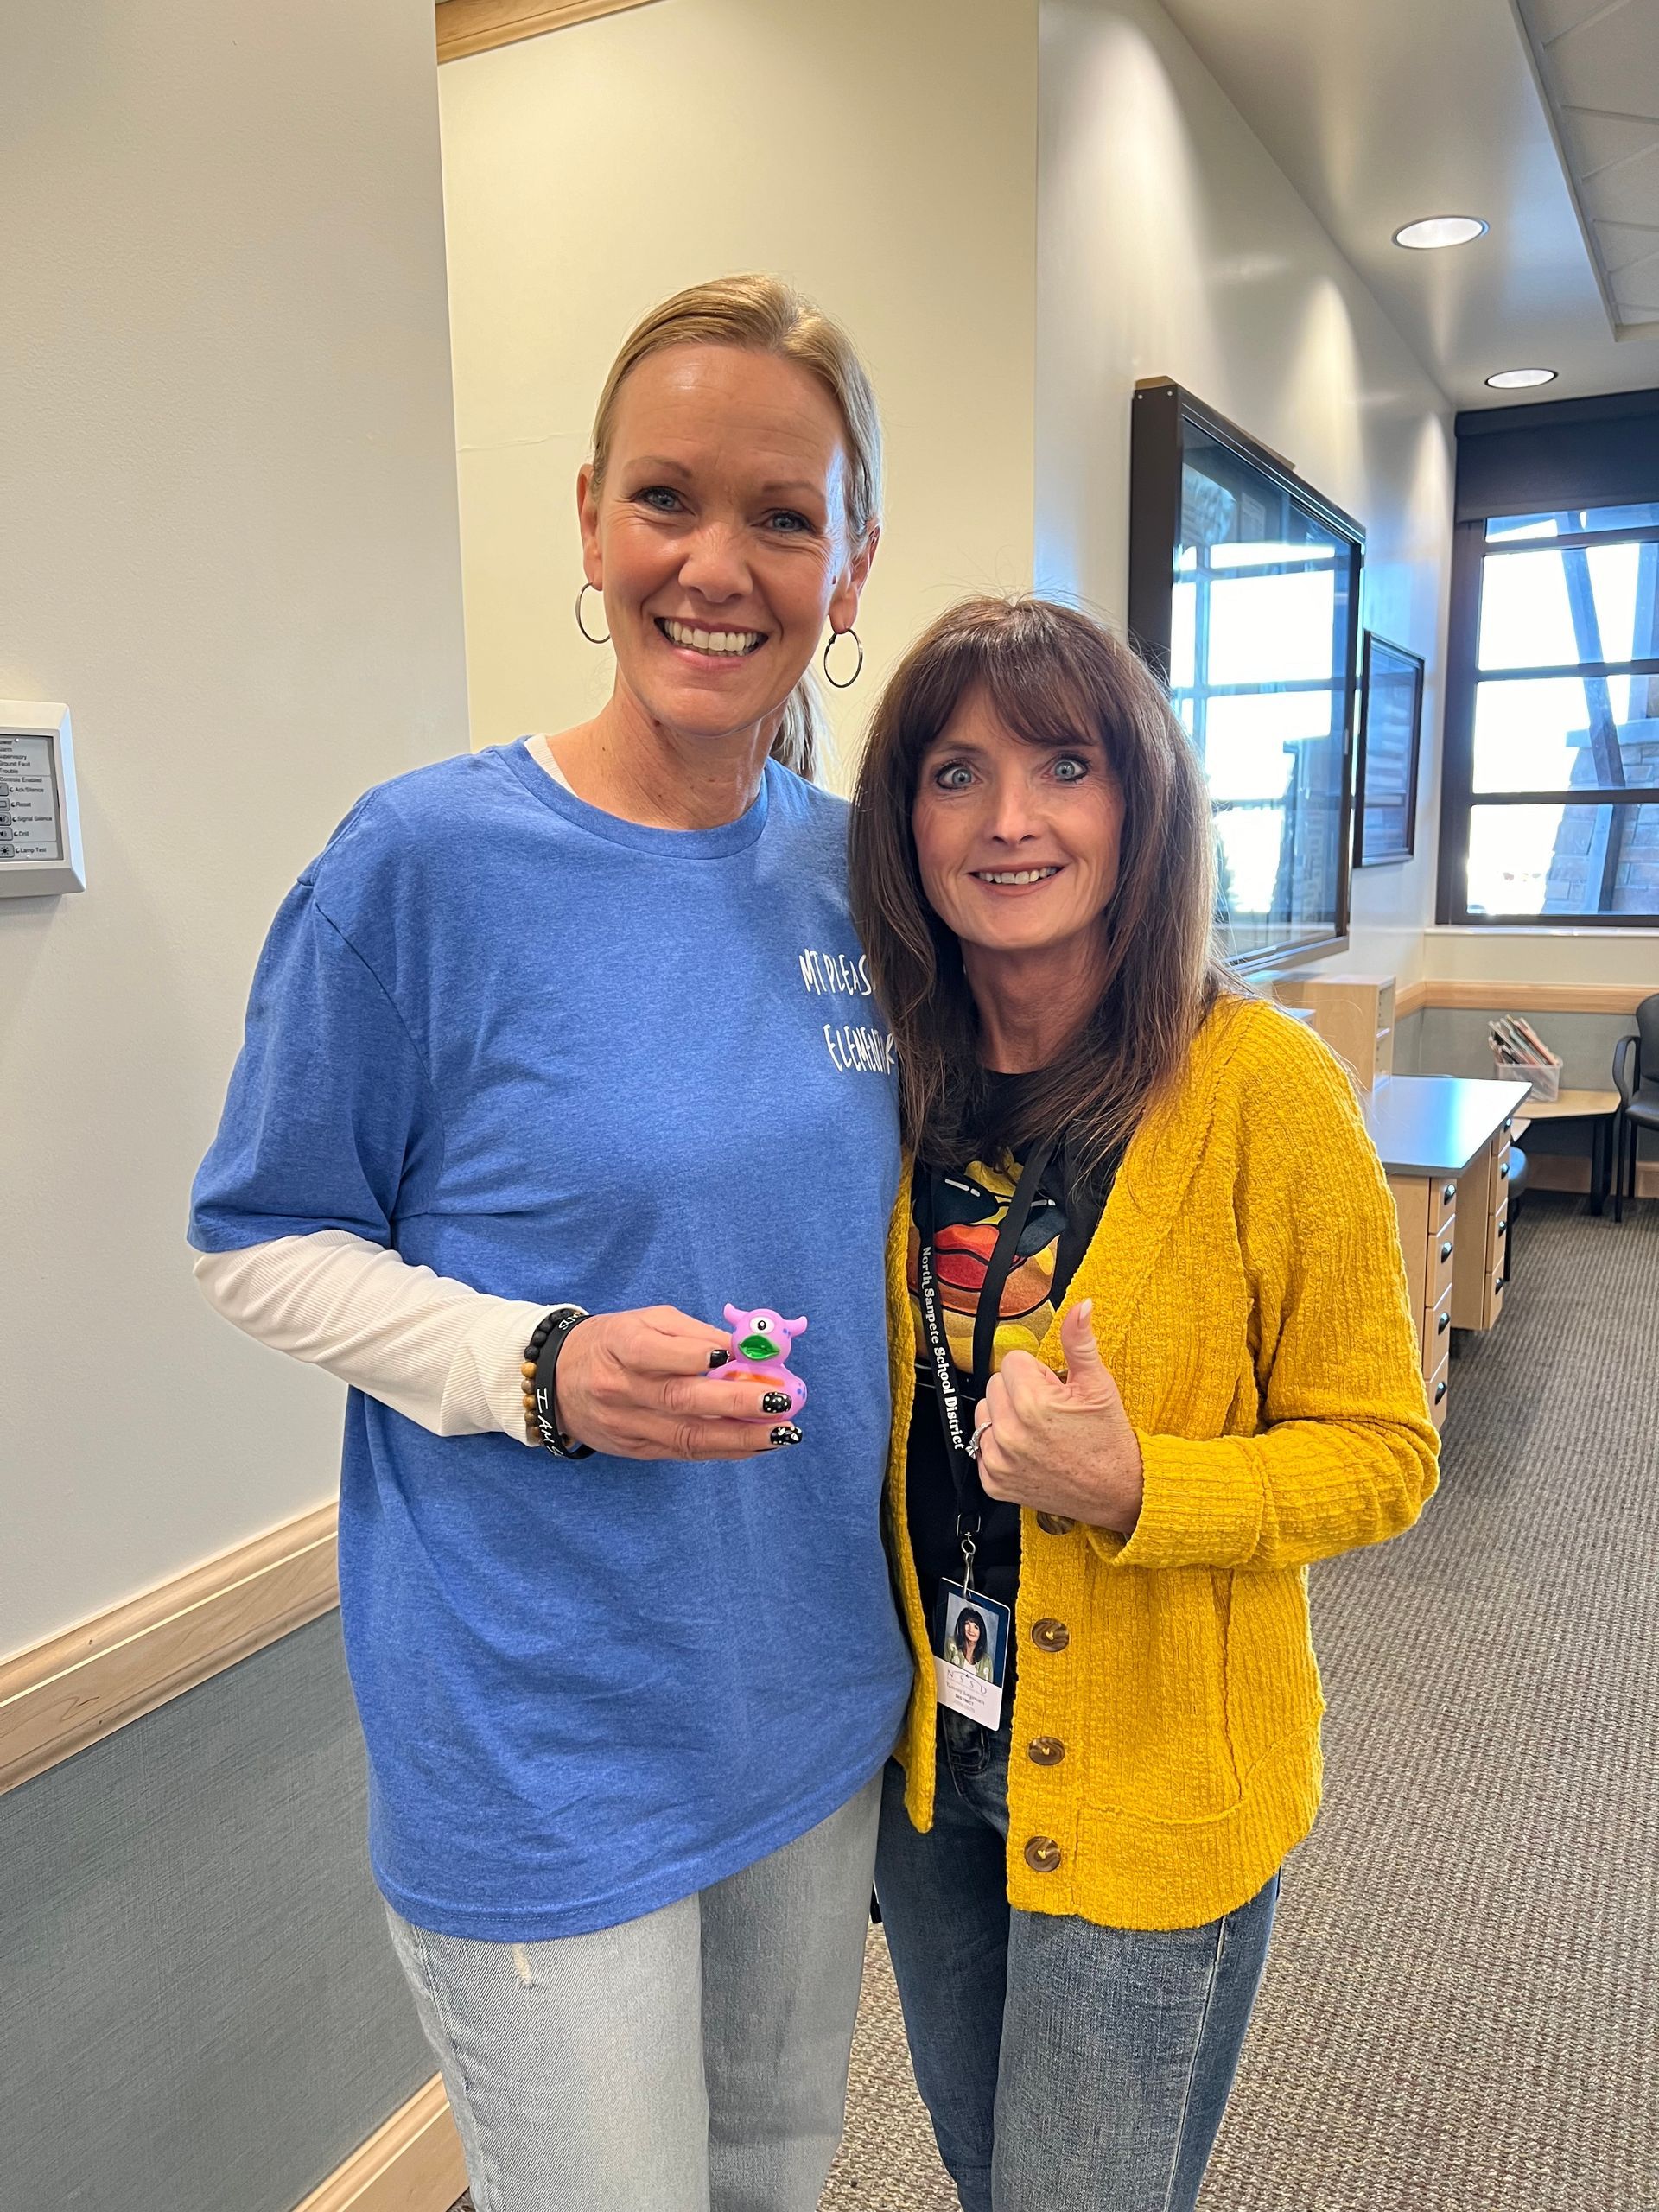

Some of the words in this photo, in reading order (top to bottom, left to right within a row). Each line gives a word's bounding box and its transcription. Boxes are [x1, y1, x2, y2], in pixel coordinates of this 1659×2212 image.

[798, 948, 827, 995] MT
[822, 952, 873, 996] PLEAS
[921, 1246, 932, 1290] North
[924, 1287, 939, 1344] Sanpete
[934, 1347, 956, 1395] School
[944, 1396, 964, 1450] District
